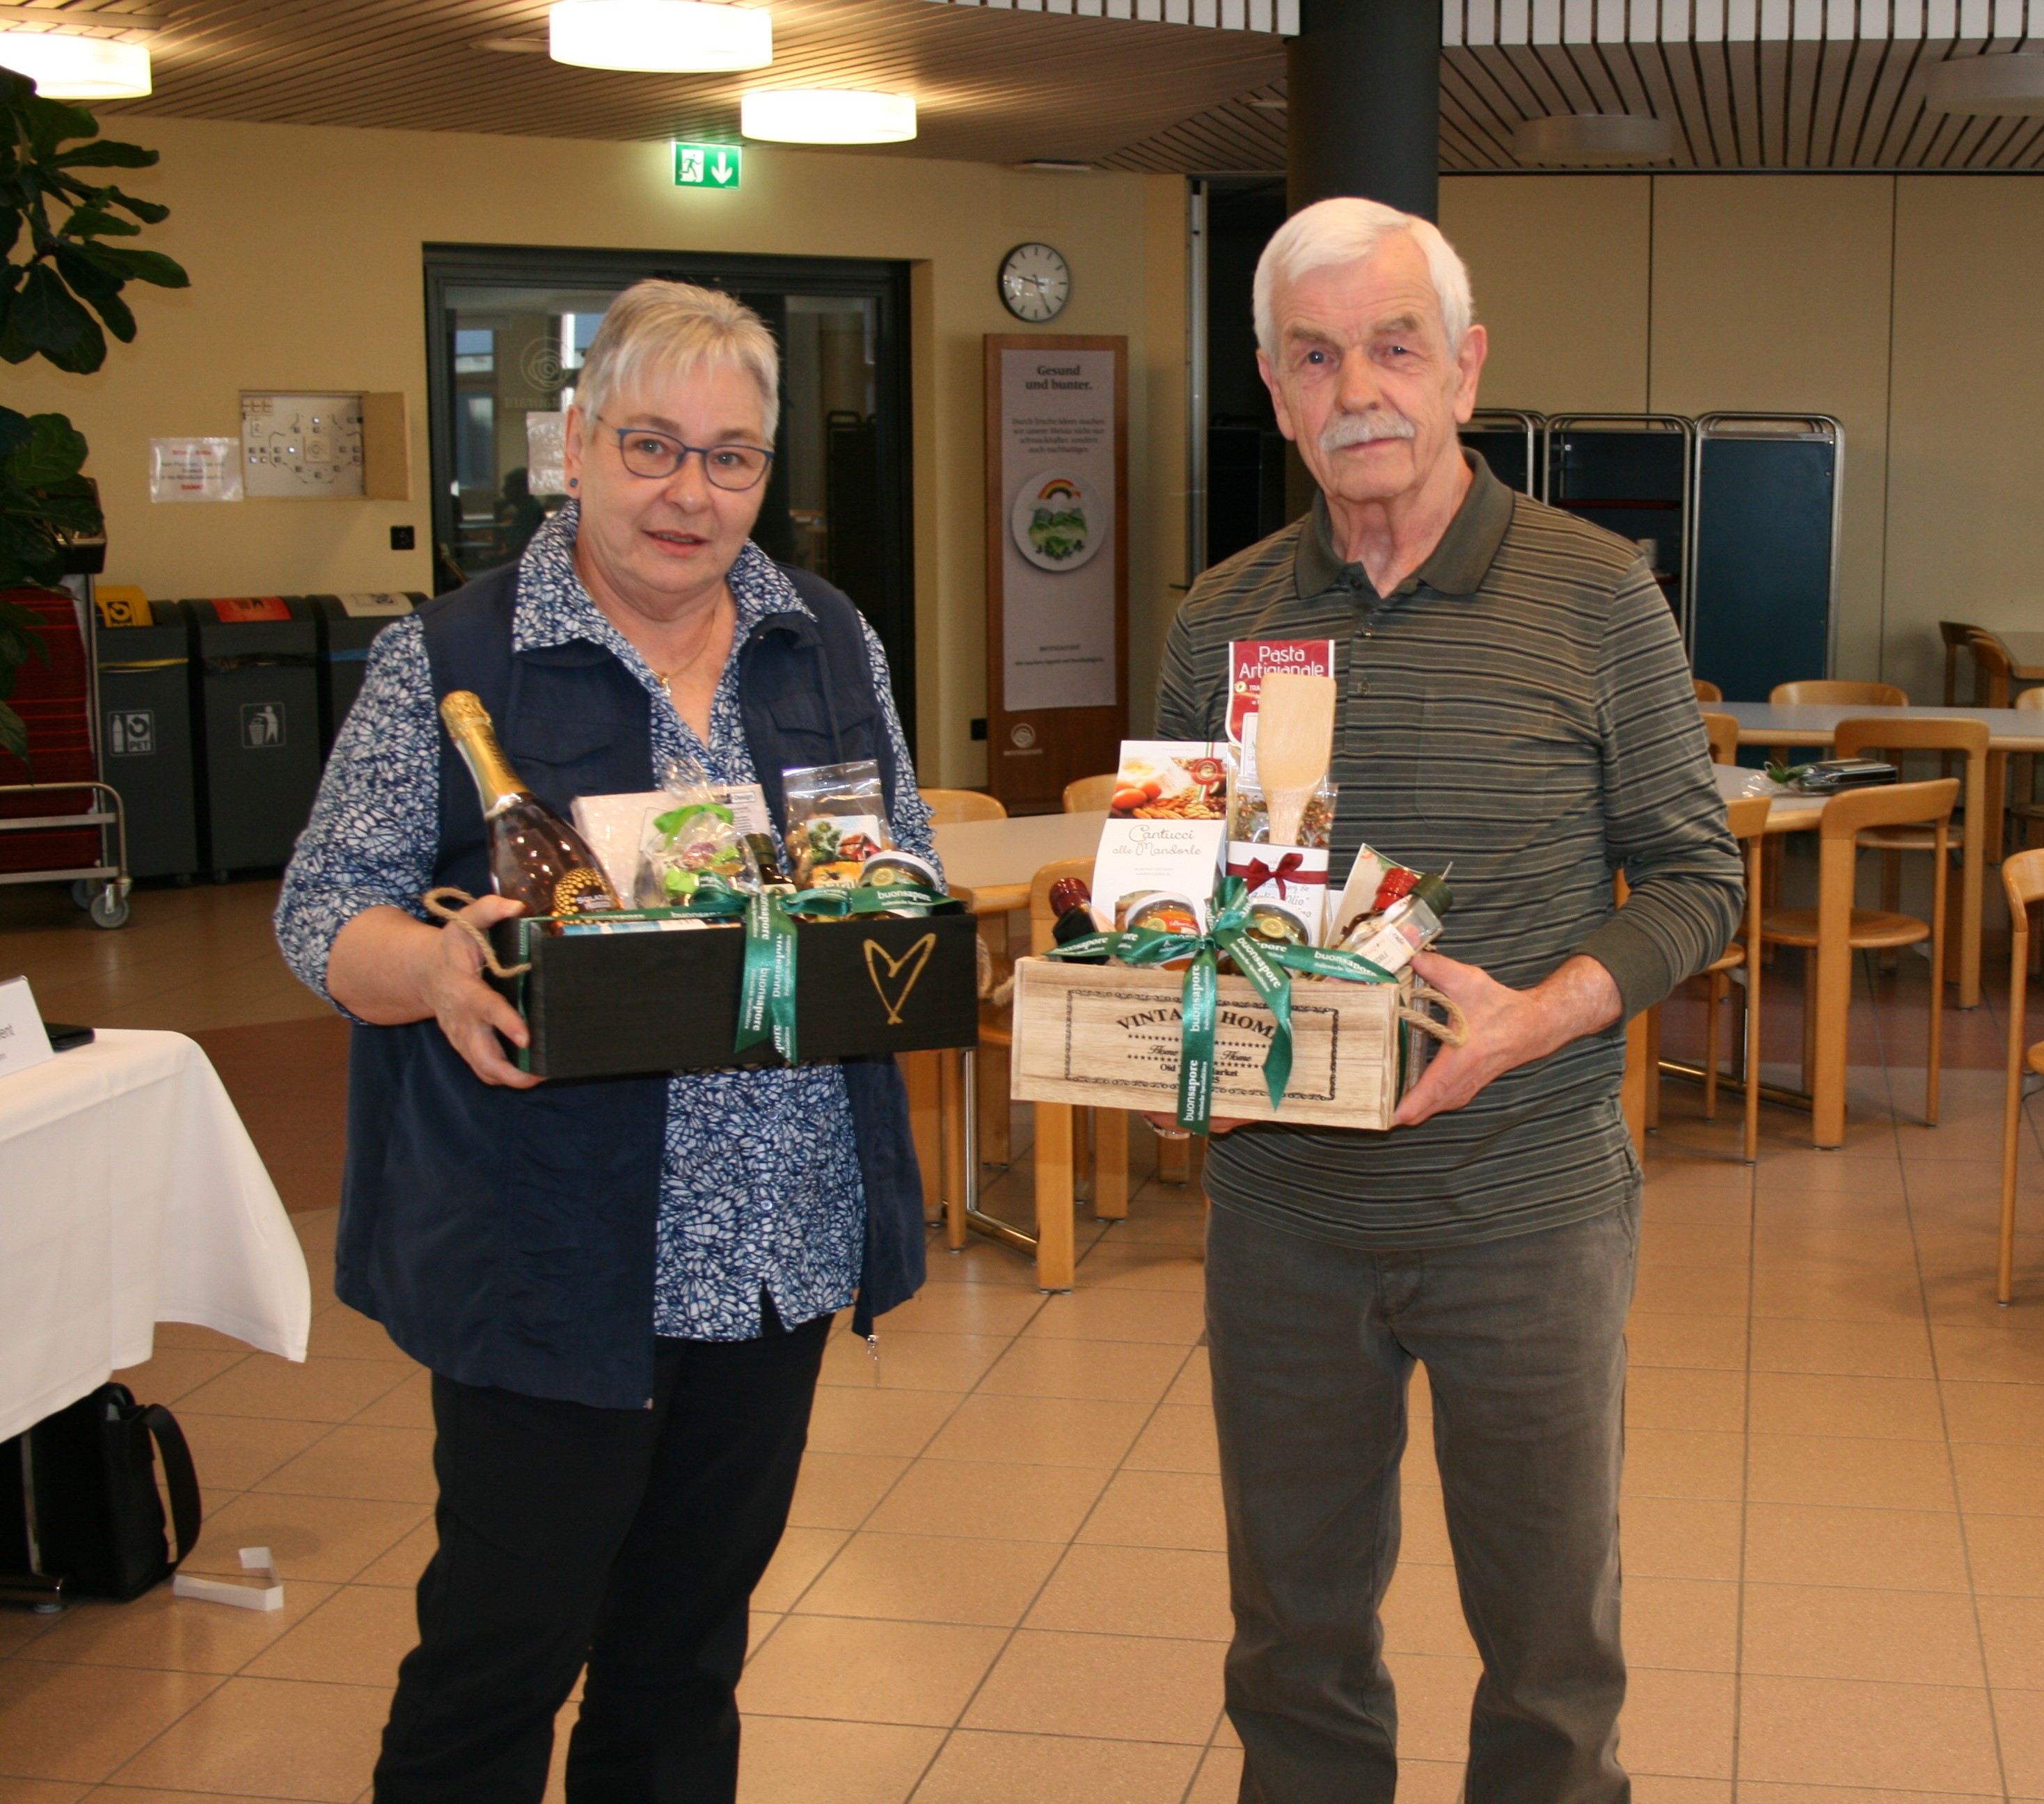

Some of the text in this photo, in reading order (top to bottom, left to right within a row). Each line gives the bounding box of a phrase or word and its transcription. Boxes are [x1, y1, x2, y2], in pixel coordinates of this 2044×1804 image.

[1037, 365, 1081, 376] Gesund
[1026, 379, 1092, 390] und bunter.
[1259, 645, 1306, 663] Pasta
[129, 740, 150, 750] PET
[1129, 824, 1194, 842] Cantucci
[1112, 841, 1201, 857] alle Mandorle
[1237, 937, 1282, 988] buonsapore
[752, 967, 771, 1031] buonsapore
[1189, 965, 1204, 1032] buonsapore
[1116, 1008, 1277, 1039] VINTA HOM
[1214, 1067, 1238, 1077] arket
[1183, 1060, 1200, 1121] buonsapore
